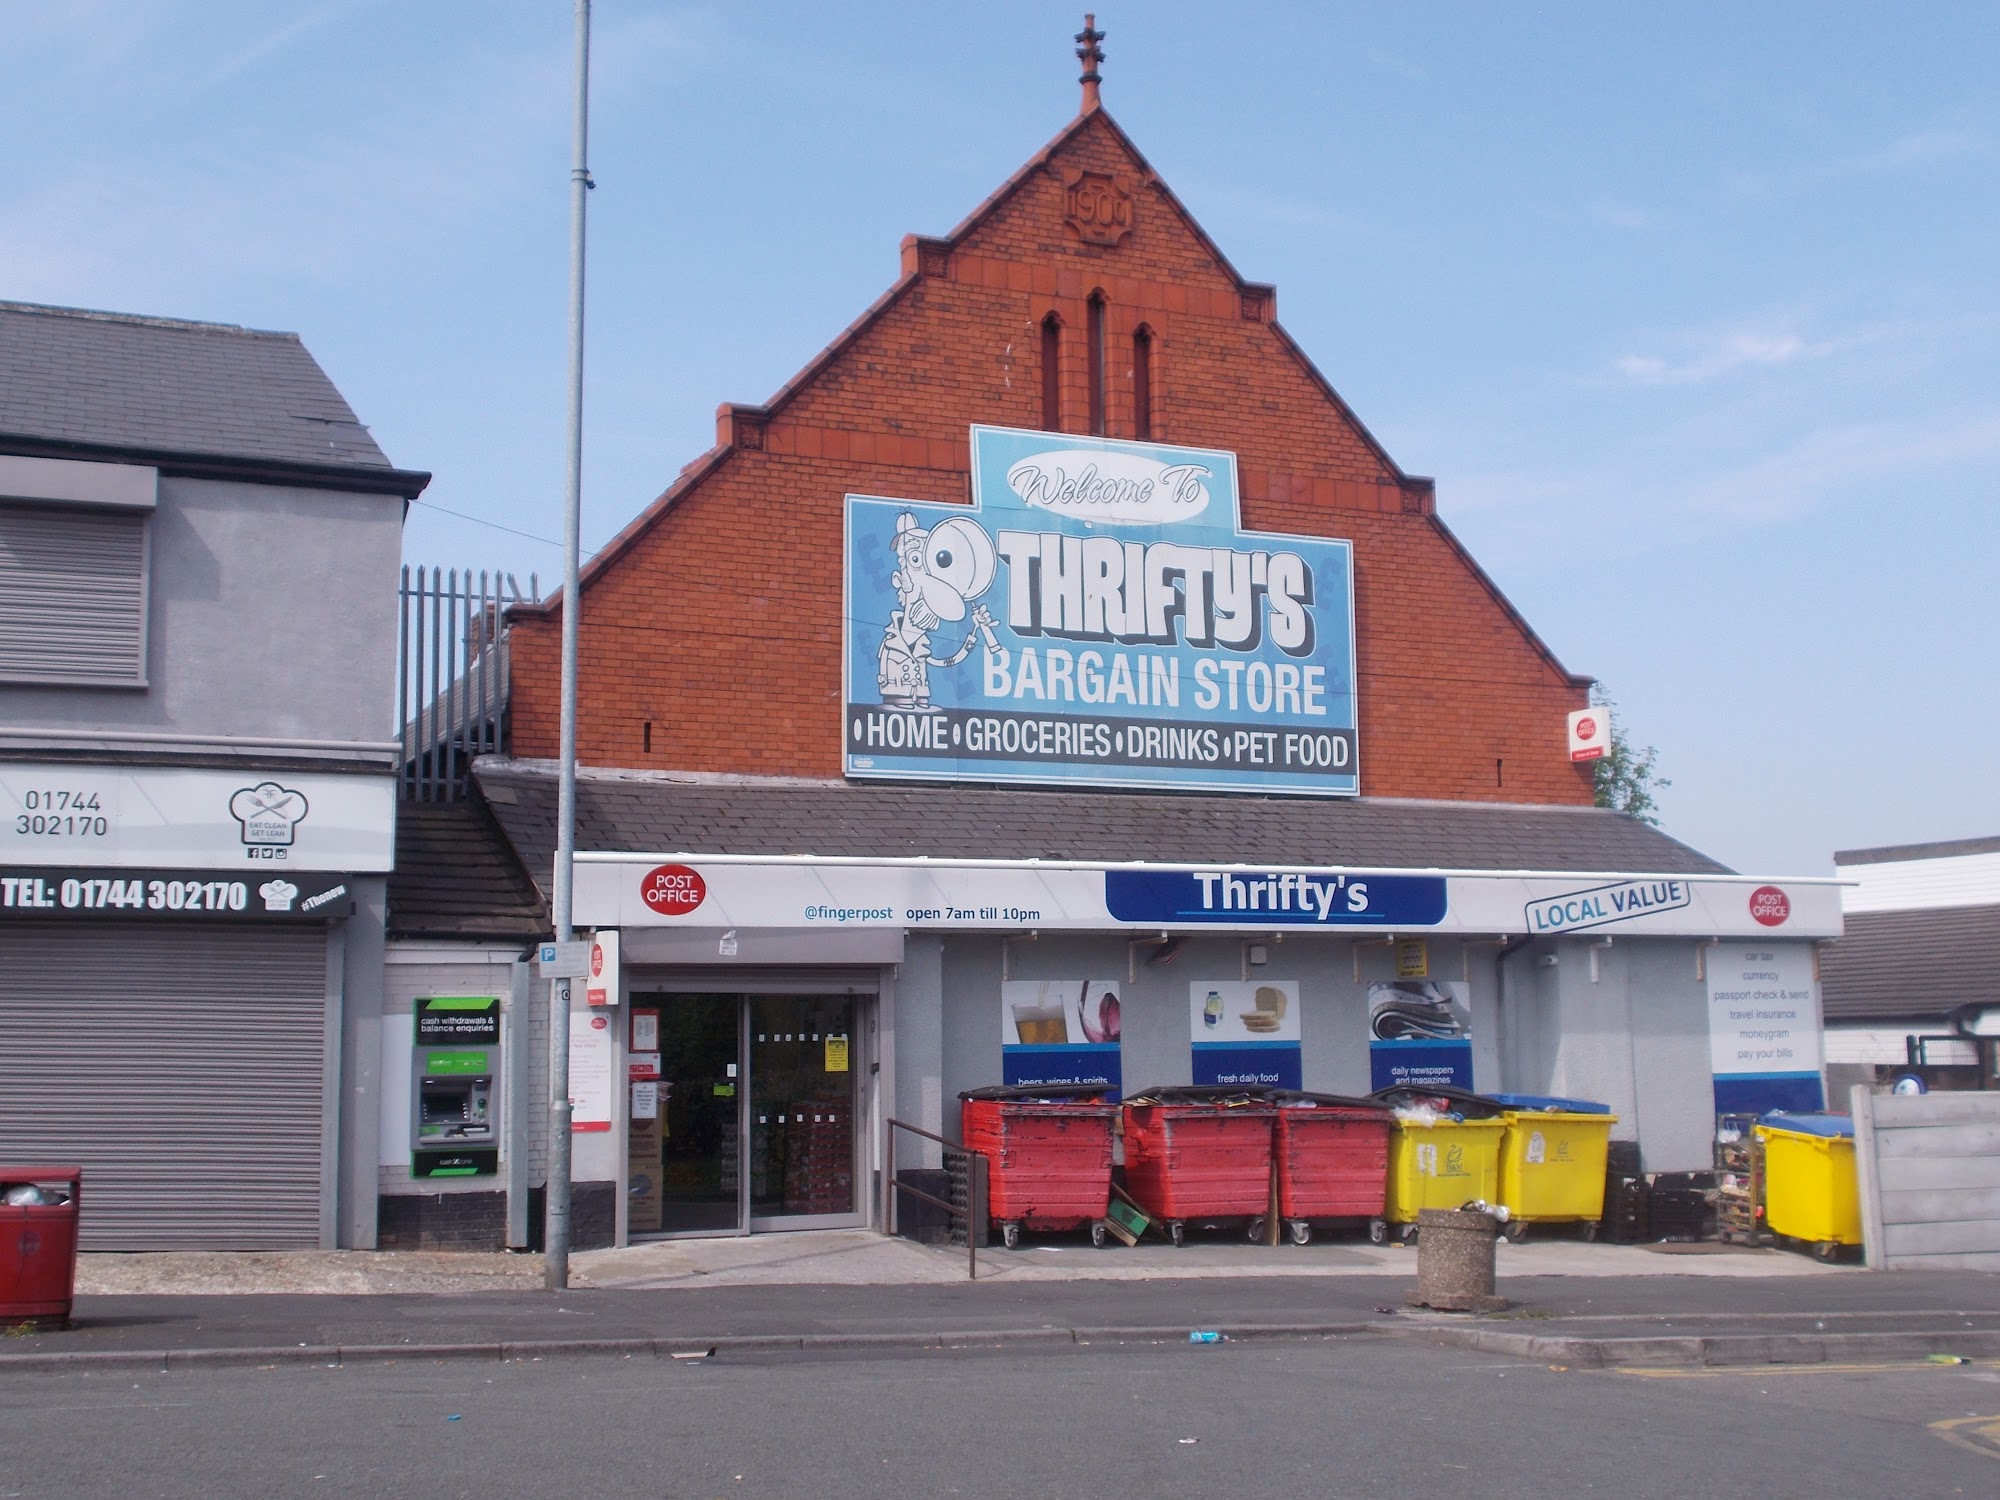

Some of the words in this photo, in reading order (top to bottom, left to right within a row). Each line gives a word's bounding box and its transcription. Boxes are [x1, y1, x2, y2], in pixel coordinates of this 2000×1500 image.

[1008, 463, 1154, 504] Welcome
[1159, 464, 1210, 503] To
[983, 647, 1179, 707] BARGAIN
[1195, 658, 1326, 715] STORE
[868, 712, 948, 749] HOME
[966, 717, 1111, 757] GROCERIES
[1128, 726, 1218, 761] DRINKS
[1235, 731, 1277, 764] PET
[1286, 734, 1348, 767] FOOD
[26, 791, 100, 811] 01744
[16, 815, 107, 836] 302170
[656, 875, 693, 888] POST
[1, 878, 54, 907] TEL:
[61, 879, 144, 909] 01744
[148, 881, 247, 911] 302170
[646, 889, 698, 903] OFFICE
[1193, 873, 1369, 920] Thrifty's
[1758, 894, 1783, 906] POST
[1534, 896, 1607, 930] LOCAL
[1611, 882, 1682, 912] VALUE
[1754, 905, 1787, 917] OFFICE
[804, 906, 893, 921] @fingerpost
[906, 908, 941, 921] open
[945, 907, 975, 919] 7am
[980, 907, 997, 919] till
[1002, 907, 1040, 922] 10pm
[544, 948, 553, 960] P
[1761, 952, 1774, 960] tax
[1743, 972, 1779, 982] currency
[1714, 991, 1751, 1001] passport
[1753, 990, 1778, 1000] check
[1780, 989, 1787, 999] &
[1789, 990, 1809, 999] send
[442, 1016, 486, 1024] withdrawals
[487, 1016, 493, 1024] &
[1730, 1010, 1754, 1019] travel
[1756, 1009, 1796, 1019] insurance
[455, 1025, 494, 1033] enquiries
[1740, 1030, 1789, 1041] moneygram
[1738, 1050, 1753, 1060] pay
[1756, 1050, 1775, 1060] your
[1777, 1048, 1793, 1057] bills
[1391, 1066, 1409, 1076] daily
[1410, 1067, 1454, 1076] newspapers
[1218, 1074, 1237, 1083] fresh
[1239, 1074, 1259, 1084] daily
[1260, 1073, 1279, 1082] food
[1396, 1077, 1410, 1085] and
[1411, 1076, 1451, 1084] magazines
